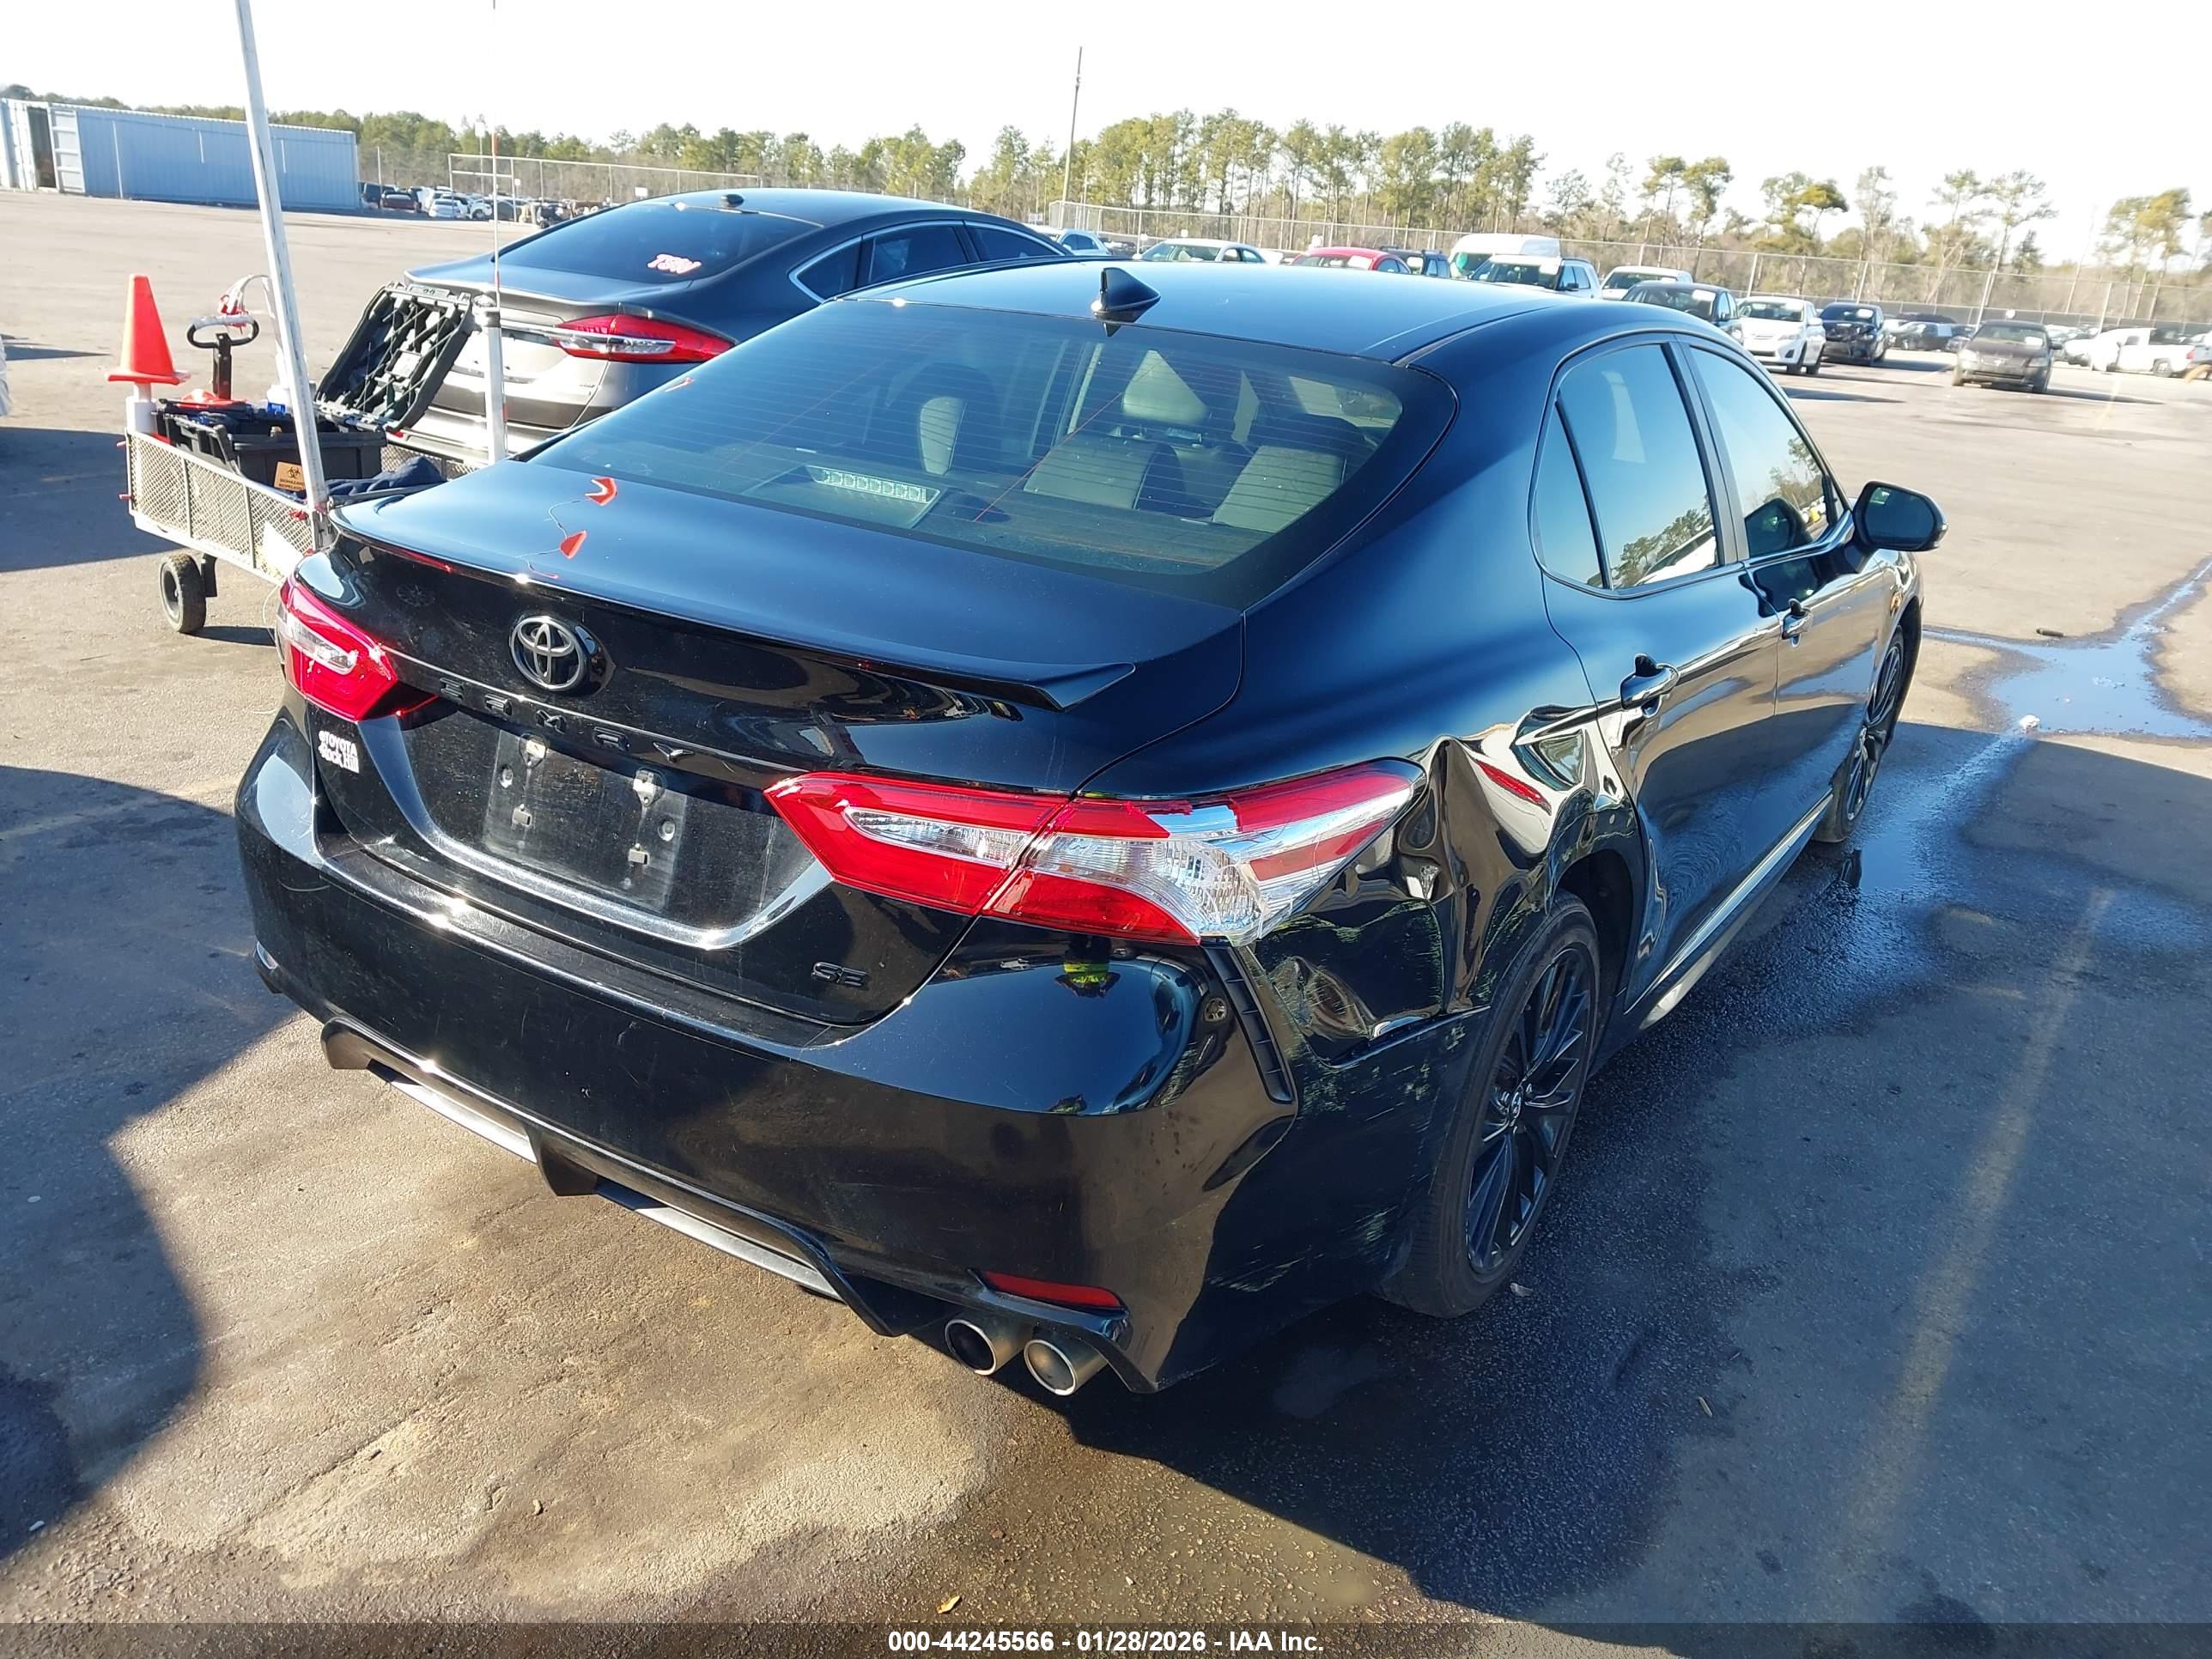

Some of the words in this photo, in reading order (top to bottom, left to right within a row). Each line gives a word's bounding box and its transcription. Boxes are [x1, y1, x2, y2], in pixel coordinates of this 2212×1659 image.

[439, 677, 695, 763] CAMRY
[318, 742, 344, 769] Rock
[324, 731, 358, 757] TOYOTA
[811, 962, 866, 988] SE
